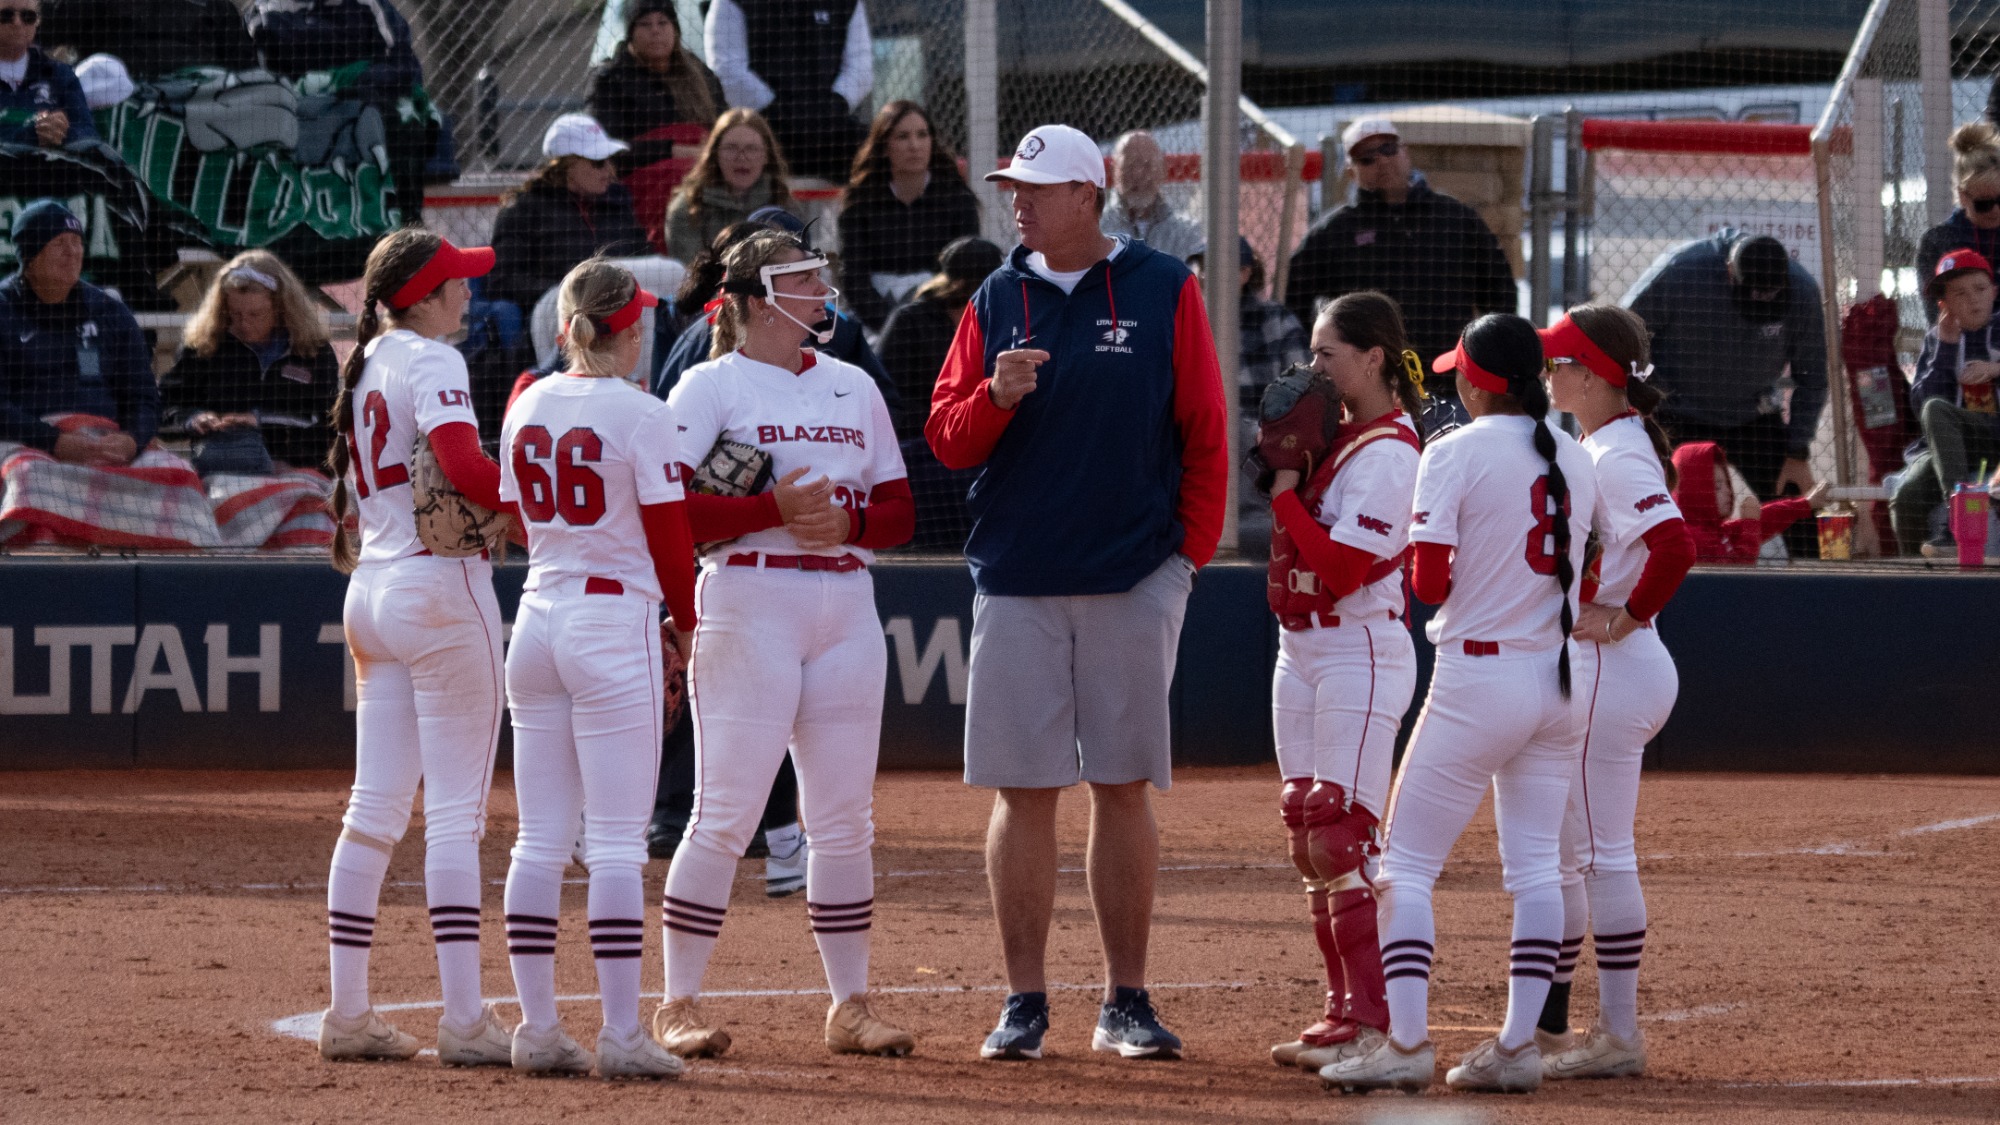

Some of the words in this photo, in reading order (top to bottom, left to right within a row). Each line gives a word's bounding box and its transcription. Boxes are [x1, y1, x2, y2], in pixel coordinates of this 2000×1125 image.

[1095, 345, 1134, 354] SOFTBALL
[1117, 320, 1138, 328] TECH
[757, 425, 866, 450] BLAZERS
[512, 424, 606, 526] 66
[1524, 474, 1572, 576] 8
[0, 623, 282, 715] UTAH
